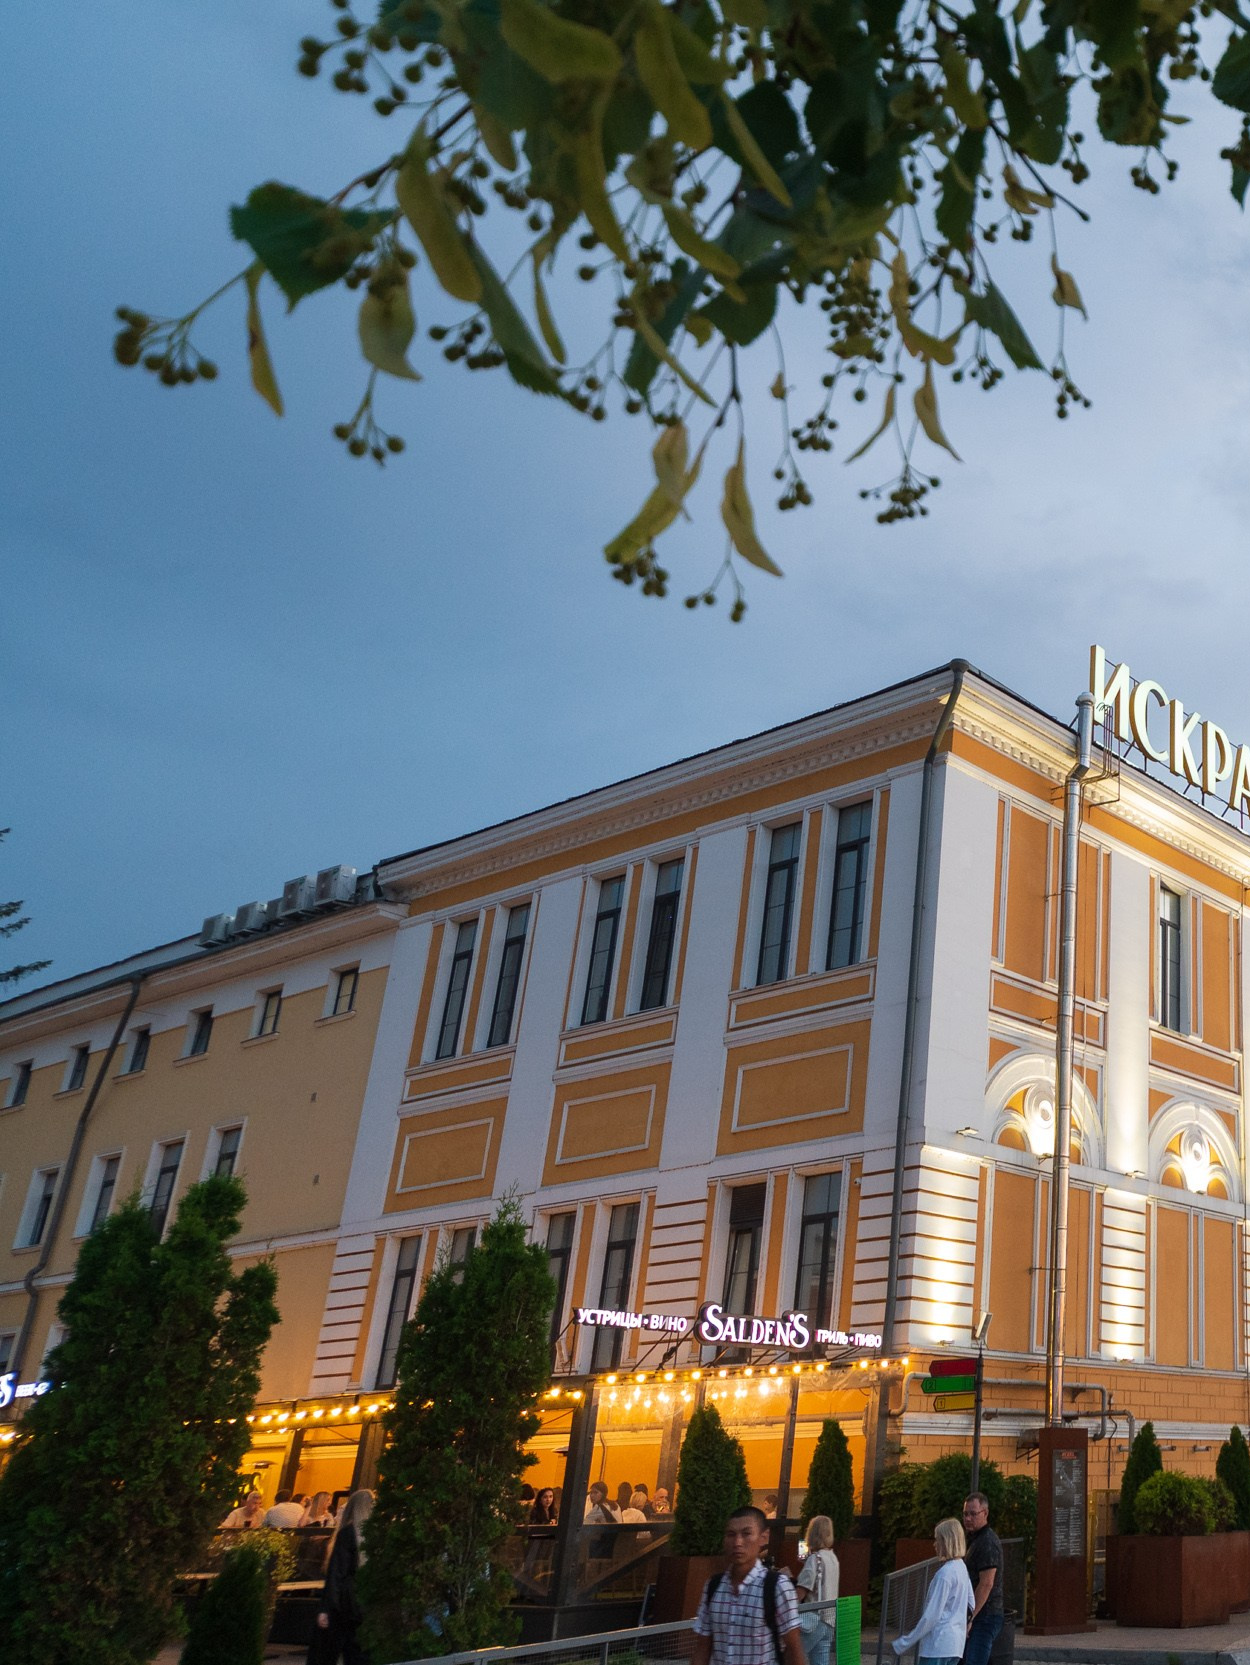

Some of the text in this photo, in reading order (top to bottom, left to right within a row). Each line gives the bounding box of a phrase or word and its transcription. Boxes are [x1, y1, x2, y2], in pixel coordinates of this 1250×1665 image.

[578, 1308, 688, 1332] УСТРИЦЫ ВИНО
[701, 1304, 810, 1348] SALDEN'S
[816, 1329, 882, 1348] ГРИЛЬ ПИВО
